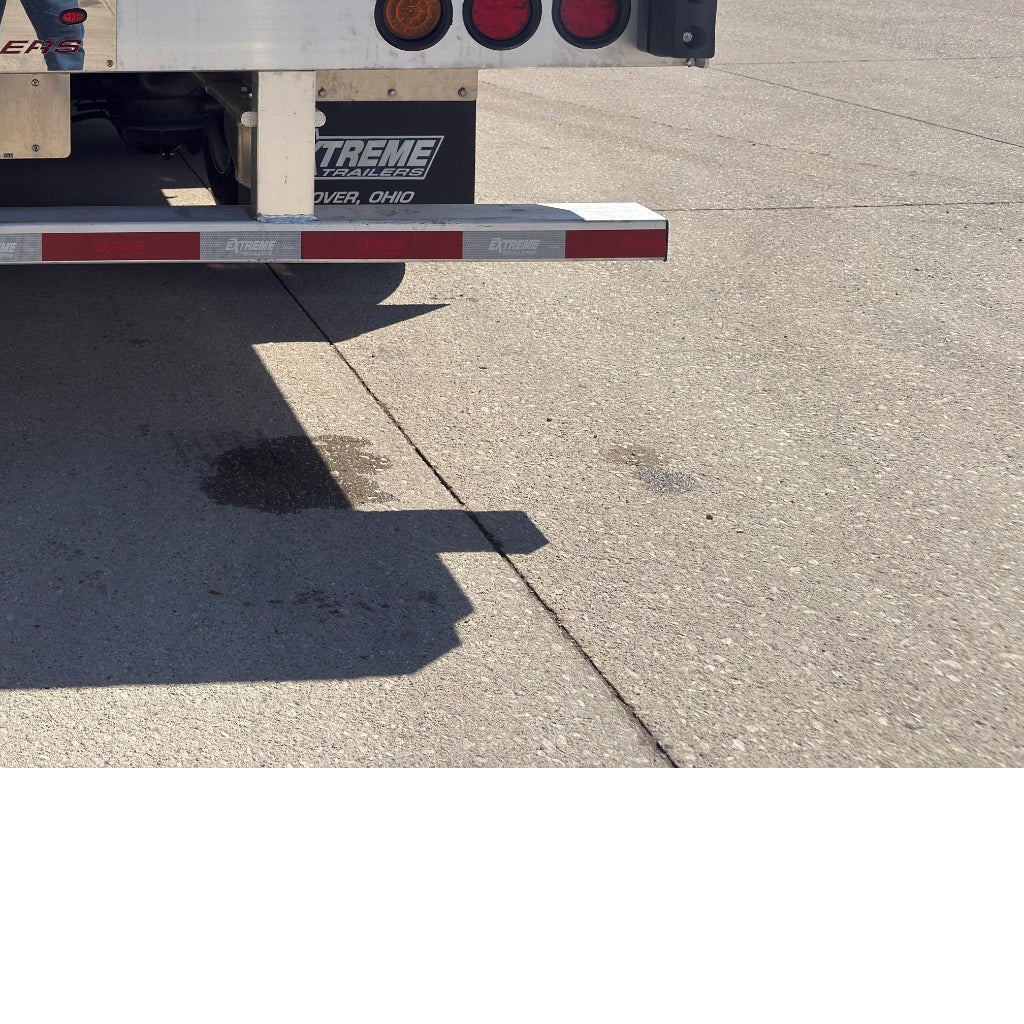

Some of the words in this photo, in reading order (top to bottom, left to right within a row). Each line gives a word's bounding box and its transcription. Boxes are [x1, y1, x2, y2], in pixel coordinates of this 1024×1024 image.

[322, 168, 425, 177] TRAILERS
[368, 191, 415, 204] OHIO
[225, 237, 277, 254] EXTREME
[488, 236, 541, 254] EXTREME
